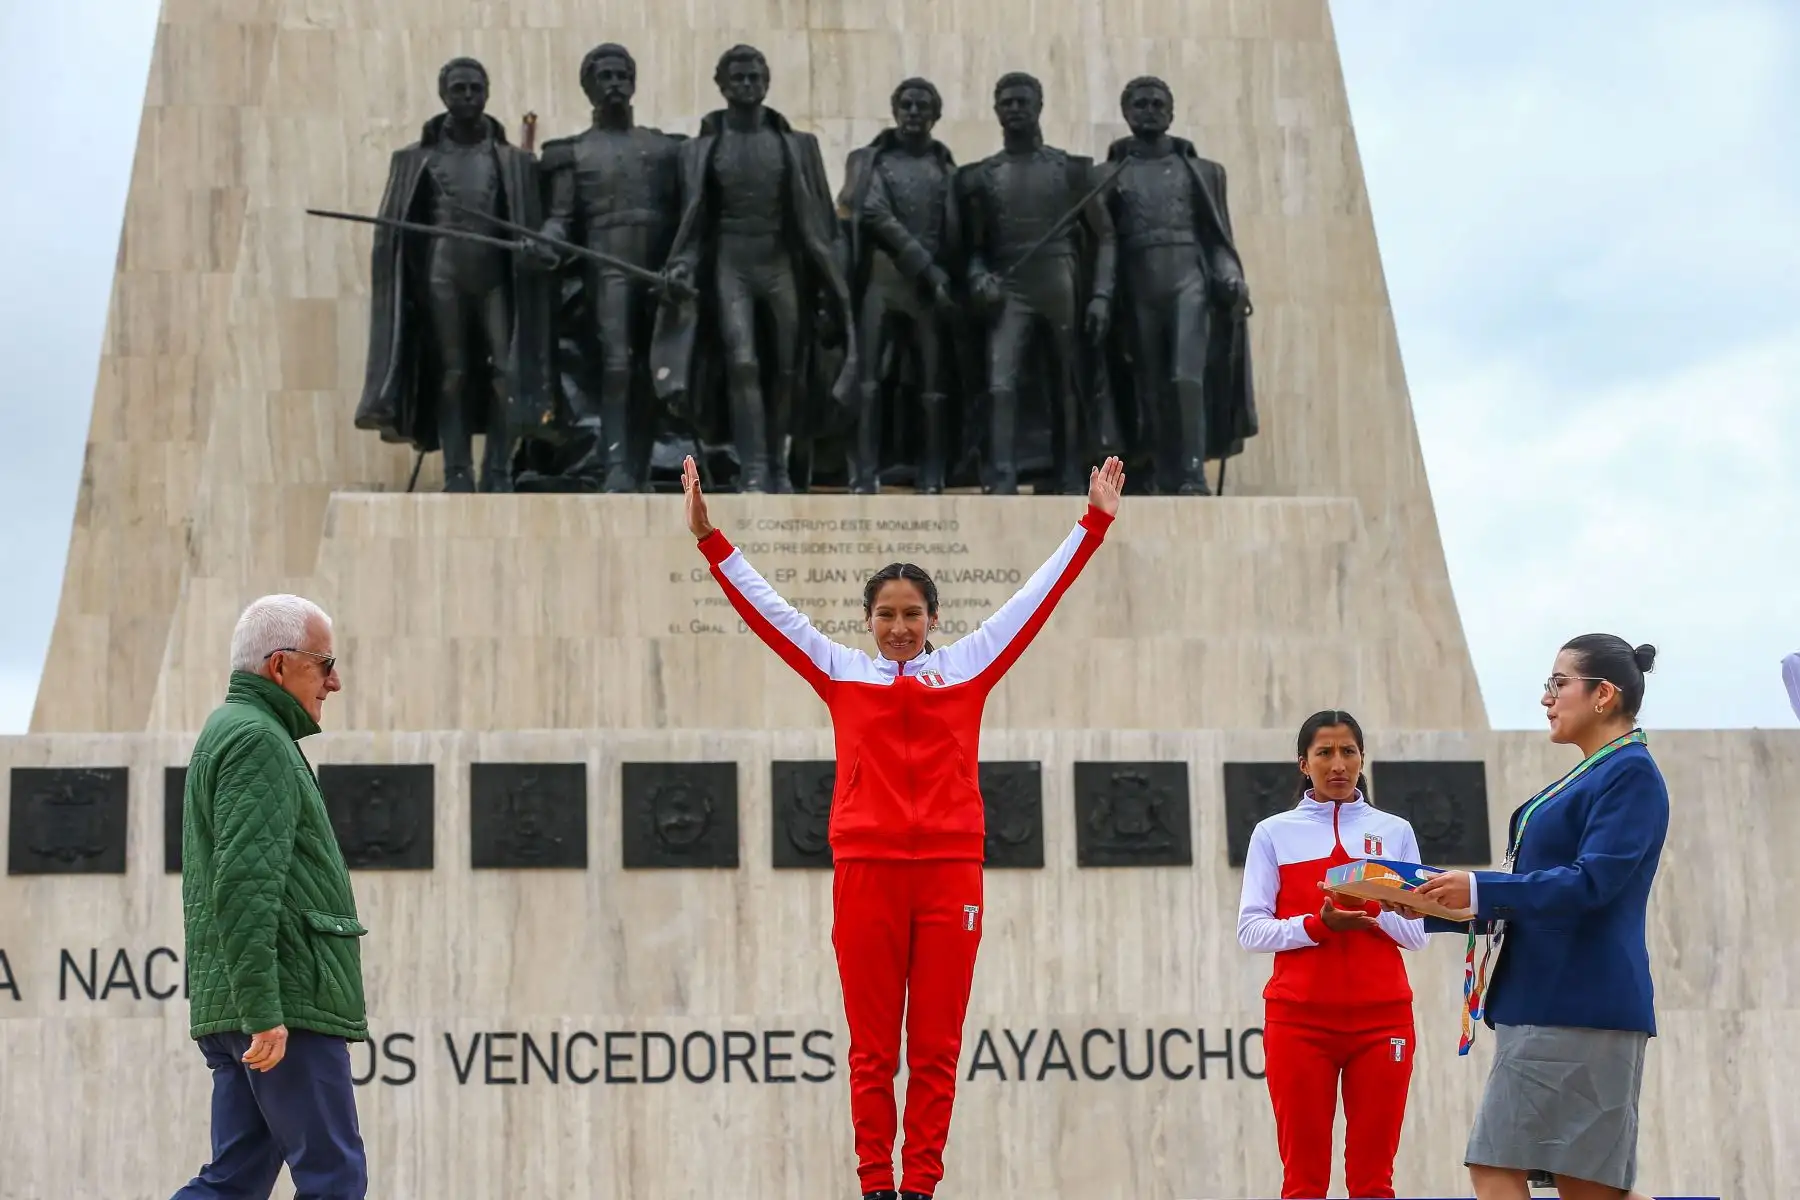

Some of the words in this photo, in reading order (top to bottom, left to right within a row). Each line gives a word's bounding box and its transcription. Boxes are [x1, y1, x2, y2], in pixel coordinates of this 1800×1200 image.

[756, 519, 837, 531] CONSTRUYO
[840, 519, 872, 531] ESTE
[876, 519, 959, 531] MONUMENTO
[772, 542, 853, 554] PRESIDENTE
[857, 542, 874, 554] DE
[878, 542, 894, 554] LA
[804, 568, 847, 583] JUAN
[934, 568, 1021, 584] ALVARADO
[59, 946, 190, 1001] NACI
[351, 1032, 416, 1085] OS
[444, 1030, 836, 1085] VENCEDORES
[966, 1027, 1265, 1081] AYACUCHO
